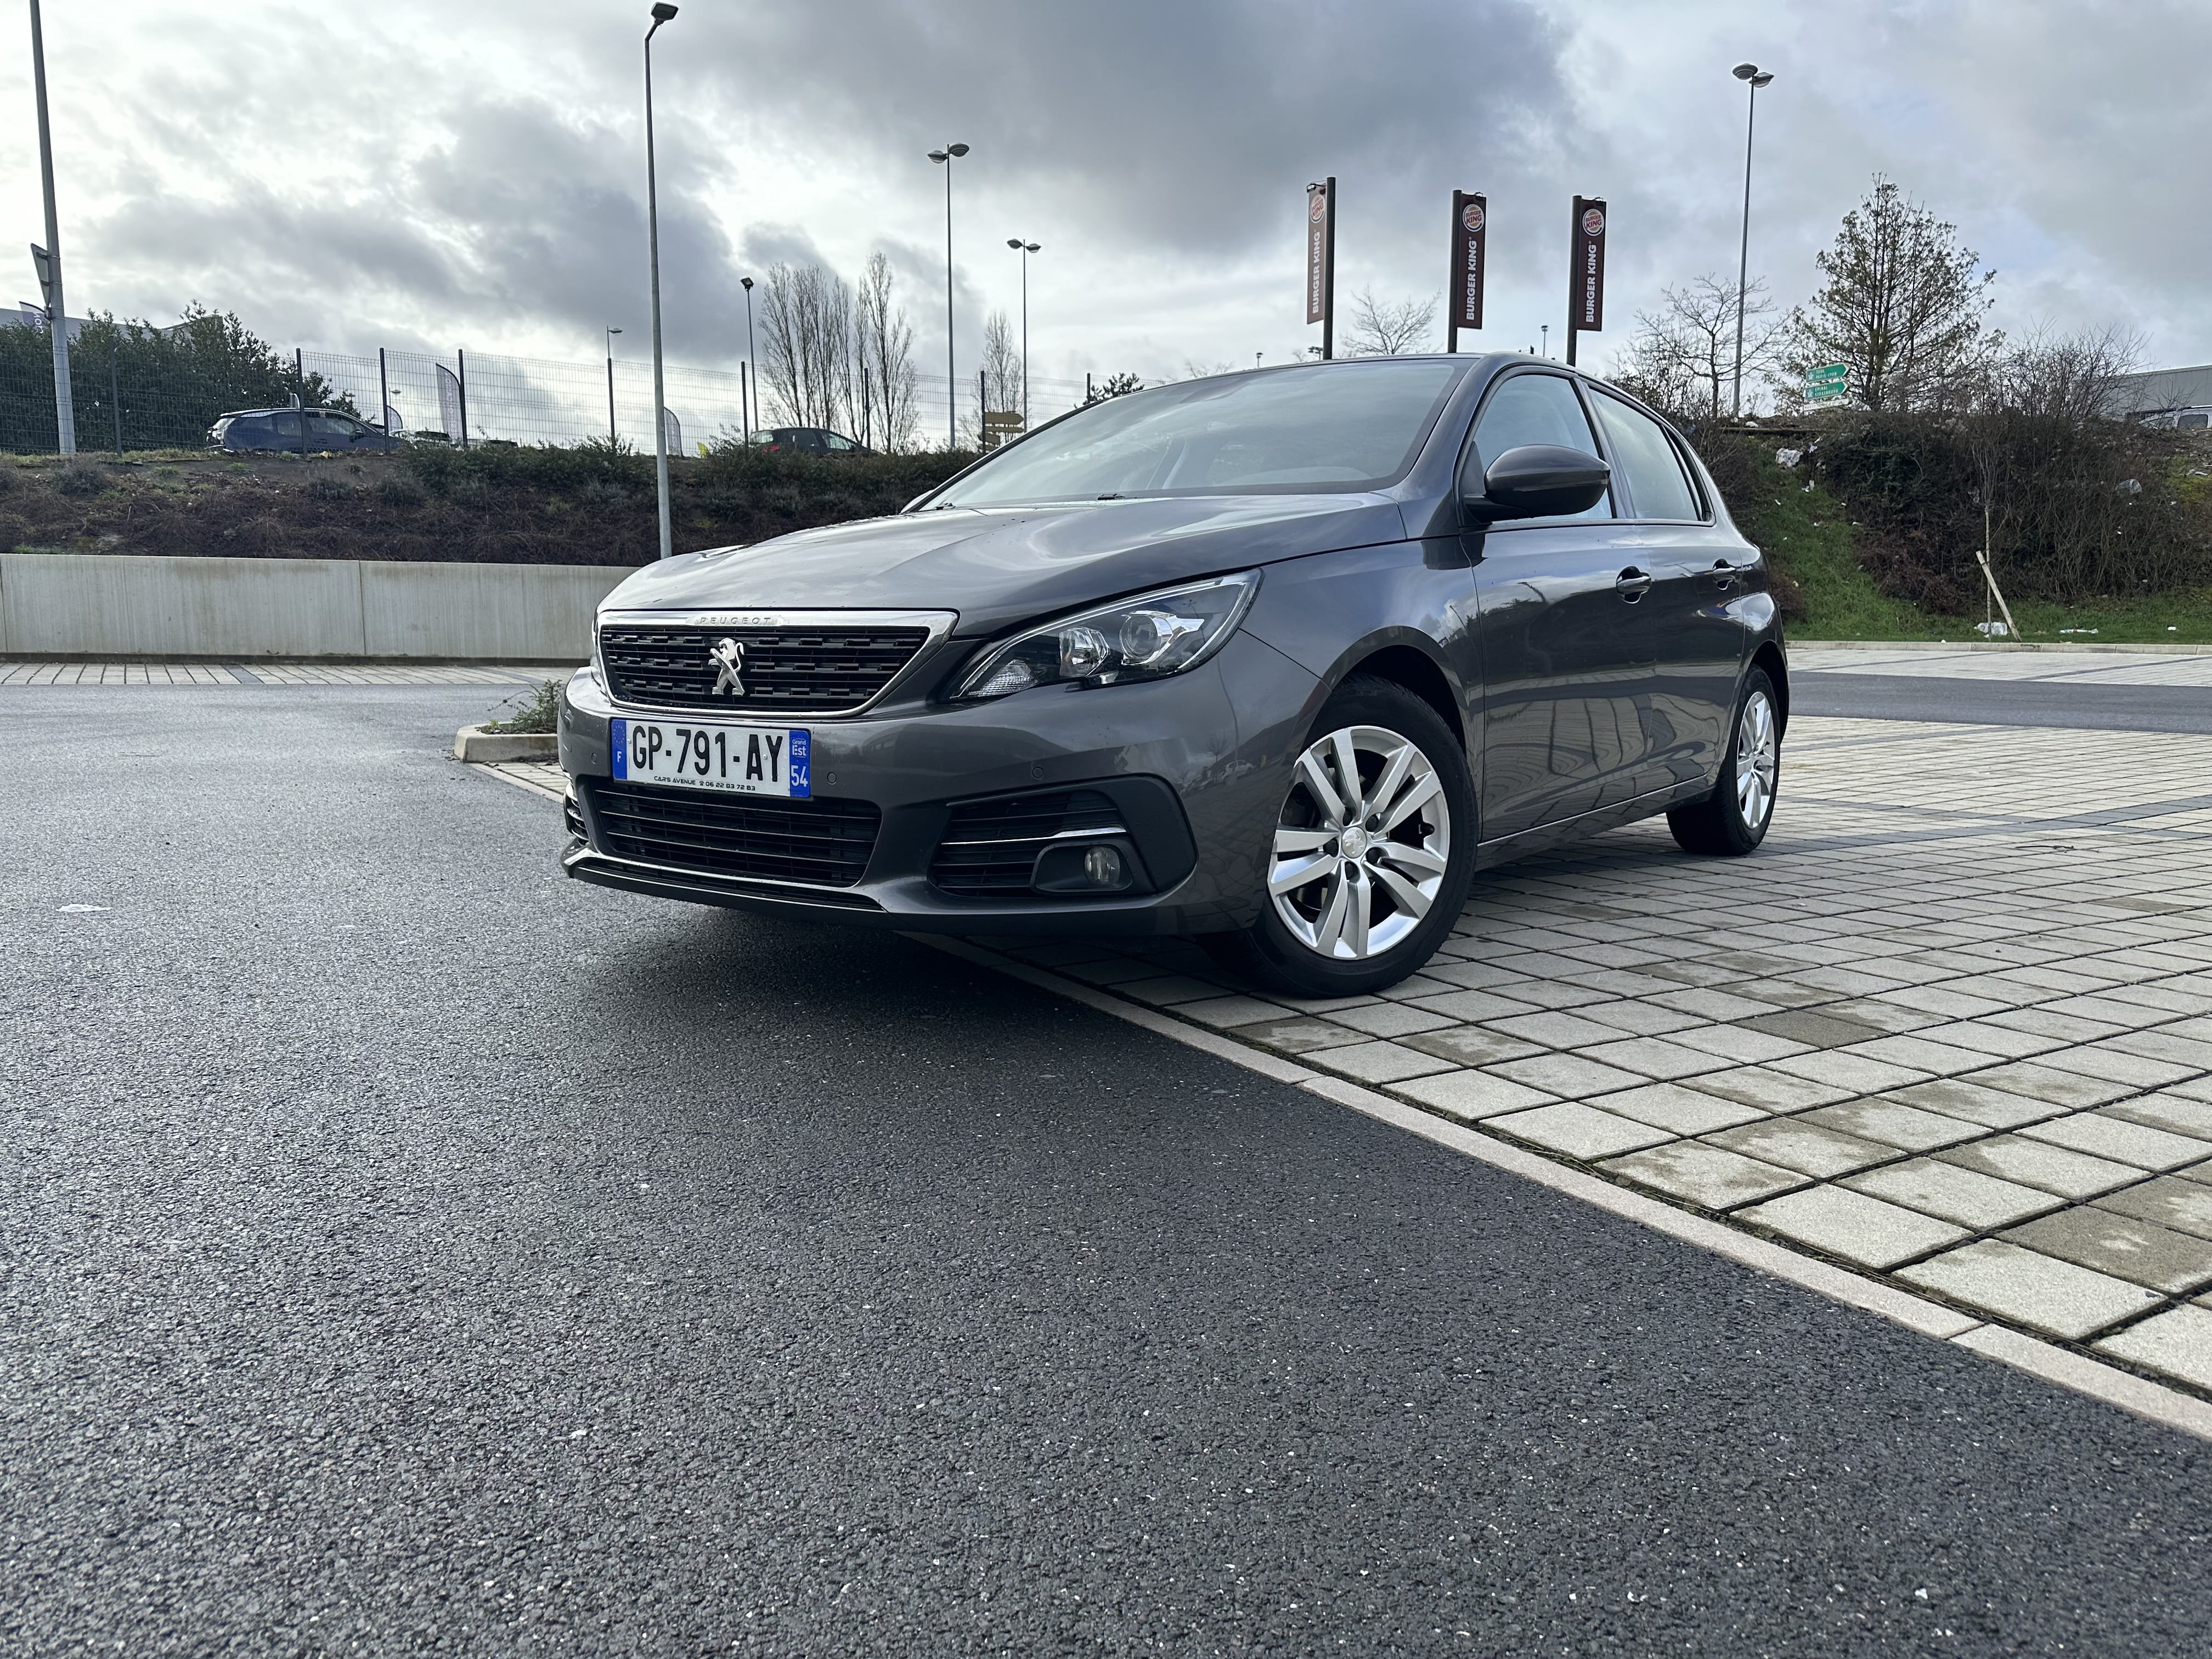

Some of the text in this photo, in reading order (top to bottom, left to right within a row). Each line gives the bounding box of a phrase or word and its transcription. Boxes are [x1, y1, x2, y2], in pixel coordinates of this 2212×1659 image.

[1466, 215, 1482, 224] KING
[1586, 219, 1601, 229] KING
[1466, 273, 1476, 320] BURGER
[1585, 276, 1595, 323] BURGER
[617, 751, 622, 763] F
[633, 725, 783, 782] GP-791-AY
[792, 745, 806, 756] Est
[791, 765, 808, 787] 54
